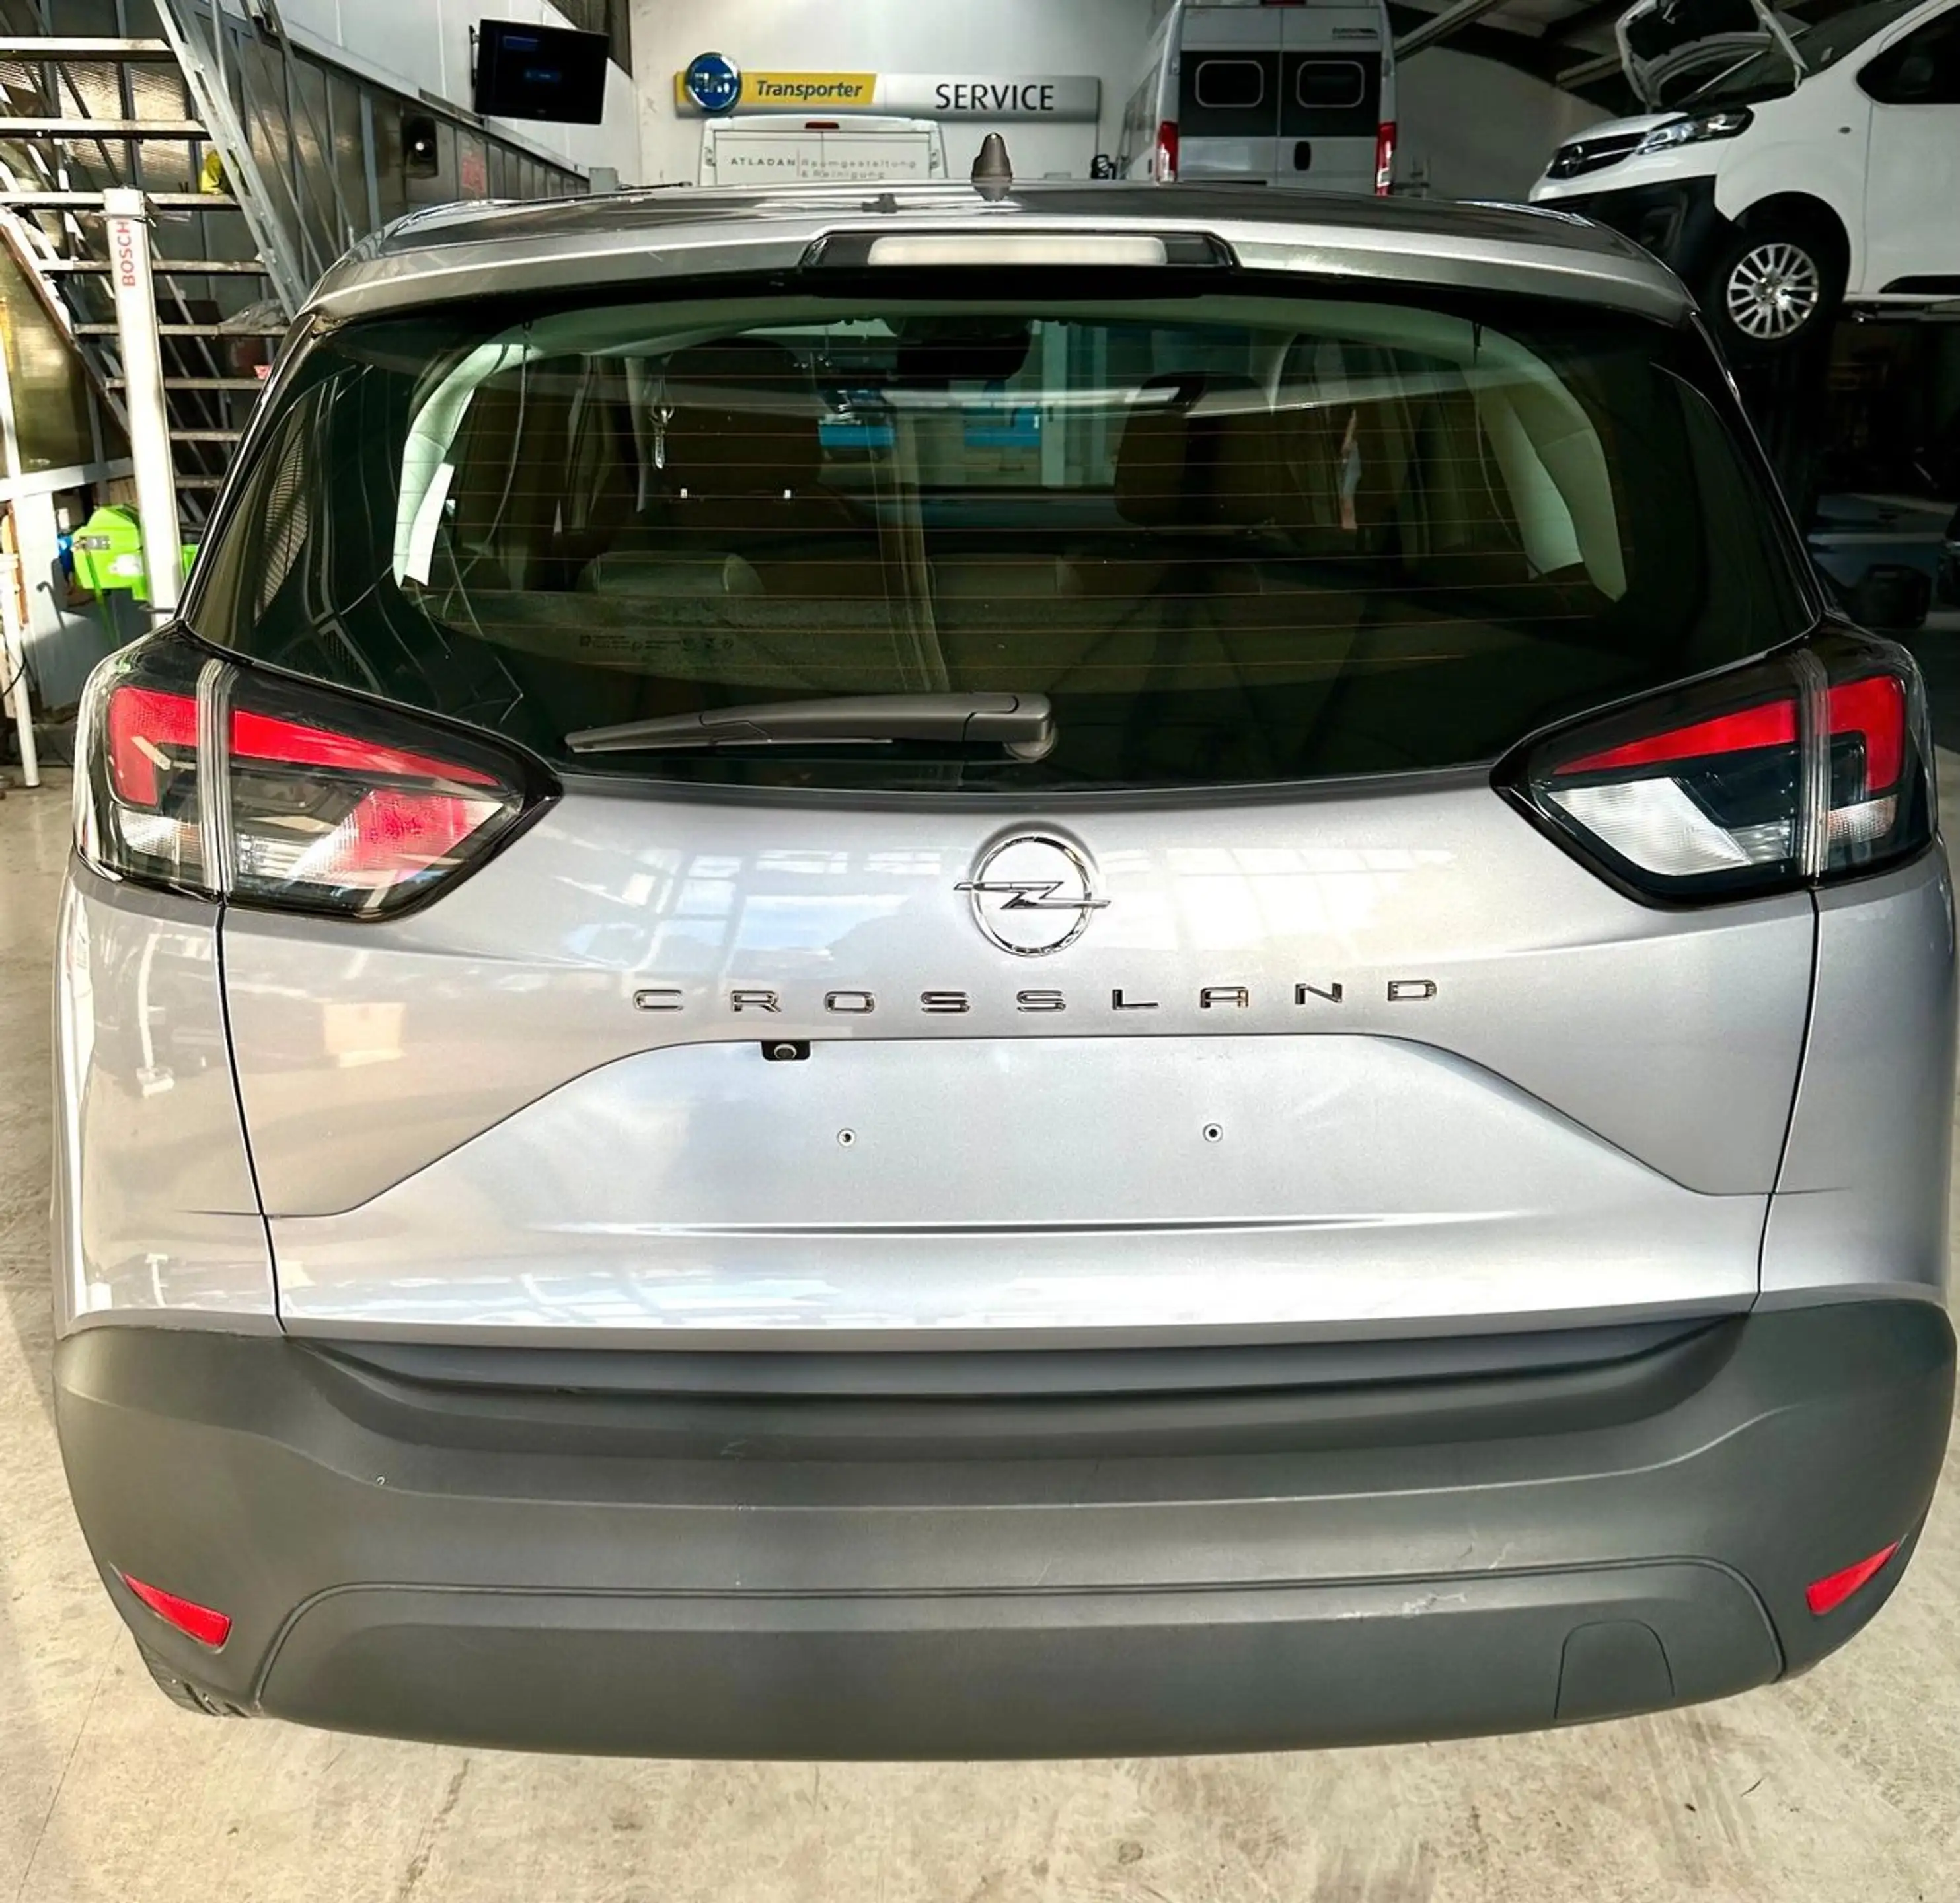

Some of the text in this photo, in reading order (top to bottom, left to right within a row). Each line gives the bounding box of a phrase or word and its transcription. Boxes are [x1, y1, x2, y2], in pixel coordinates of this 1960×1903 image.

[756, 80, 863, 100] Transporter
[935, 83, 1054, 111] SERVICE
[116, 220, 136, 287] BOSCH
[632, 979, 1439, 1013] CROSSLAND
